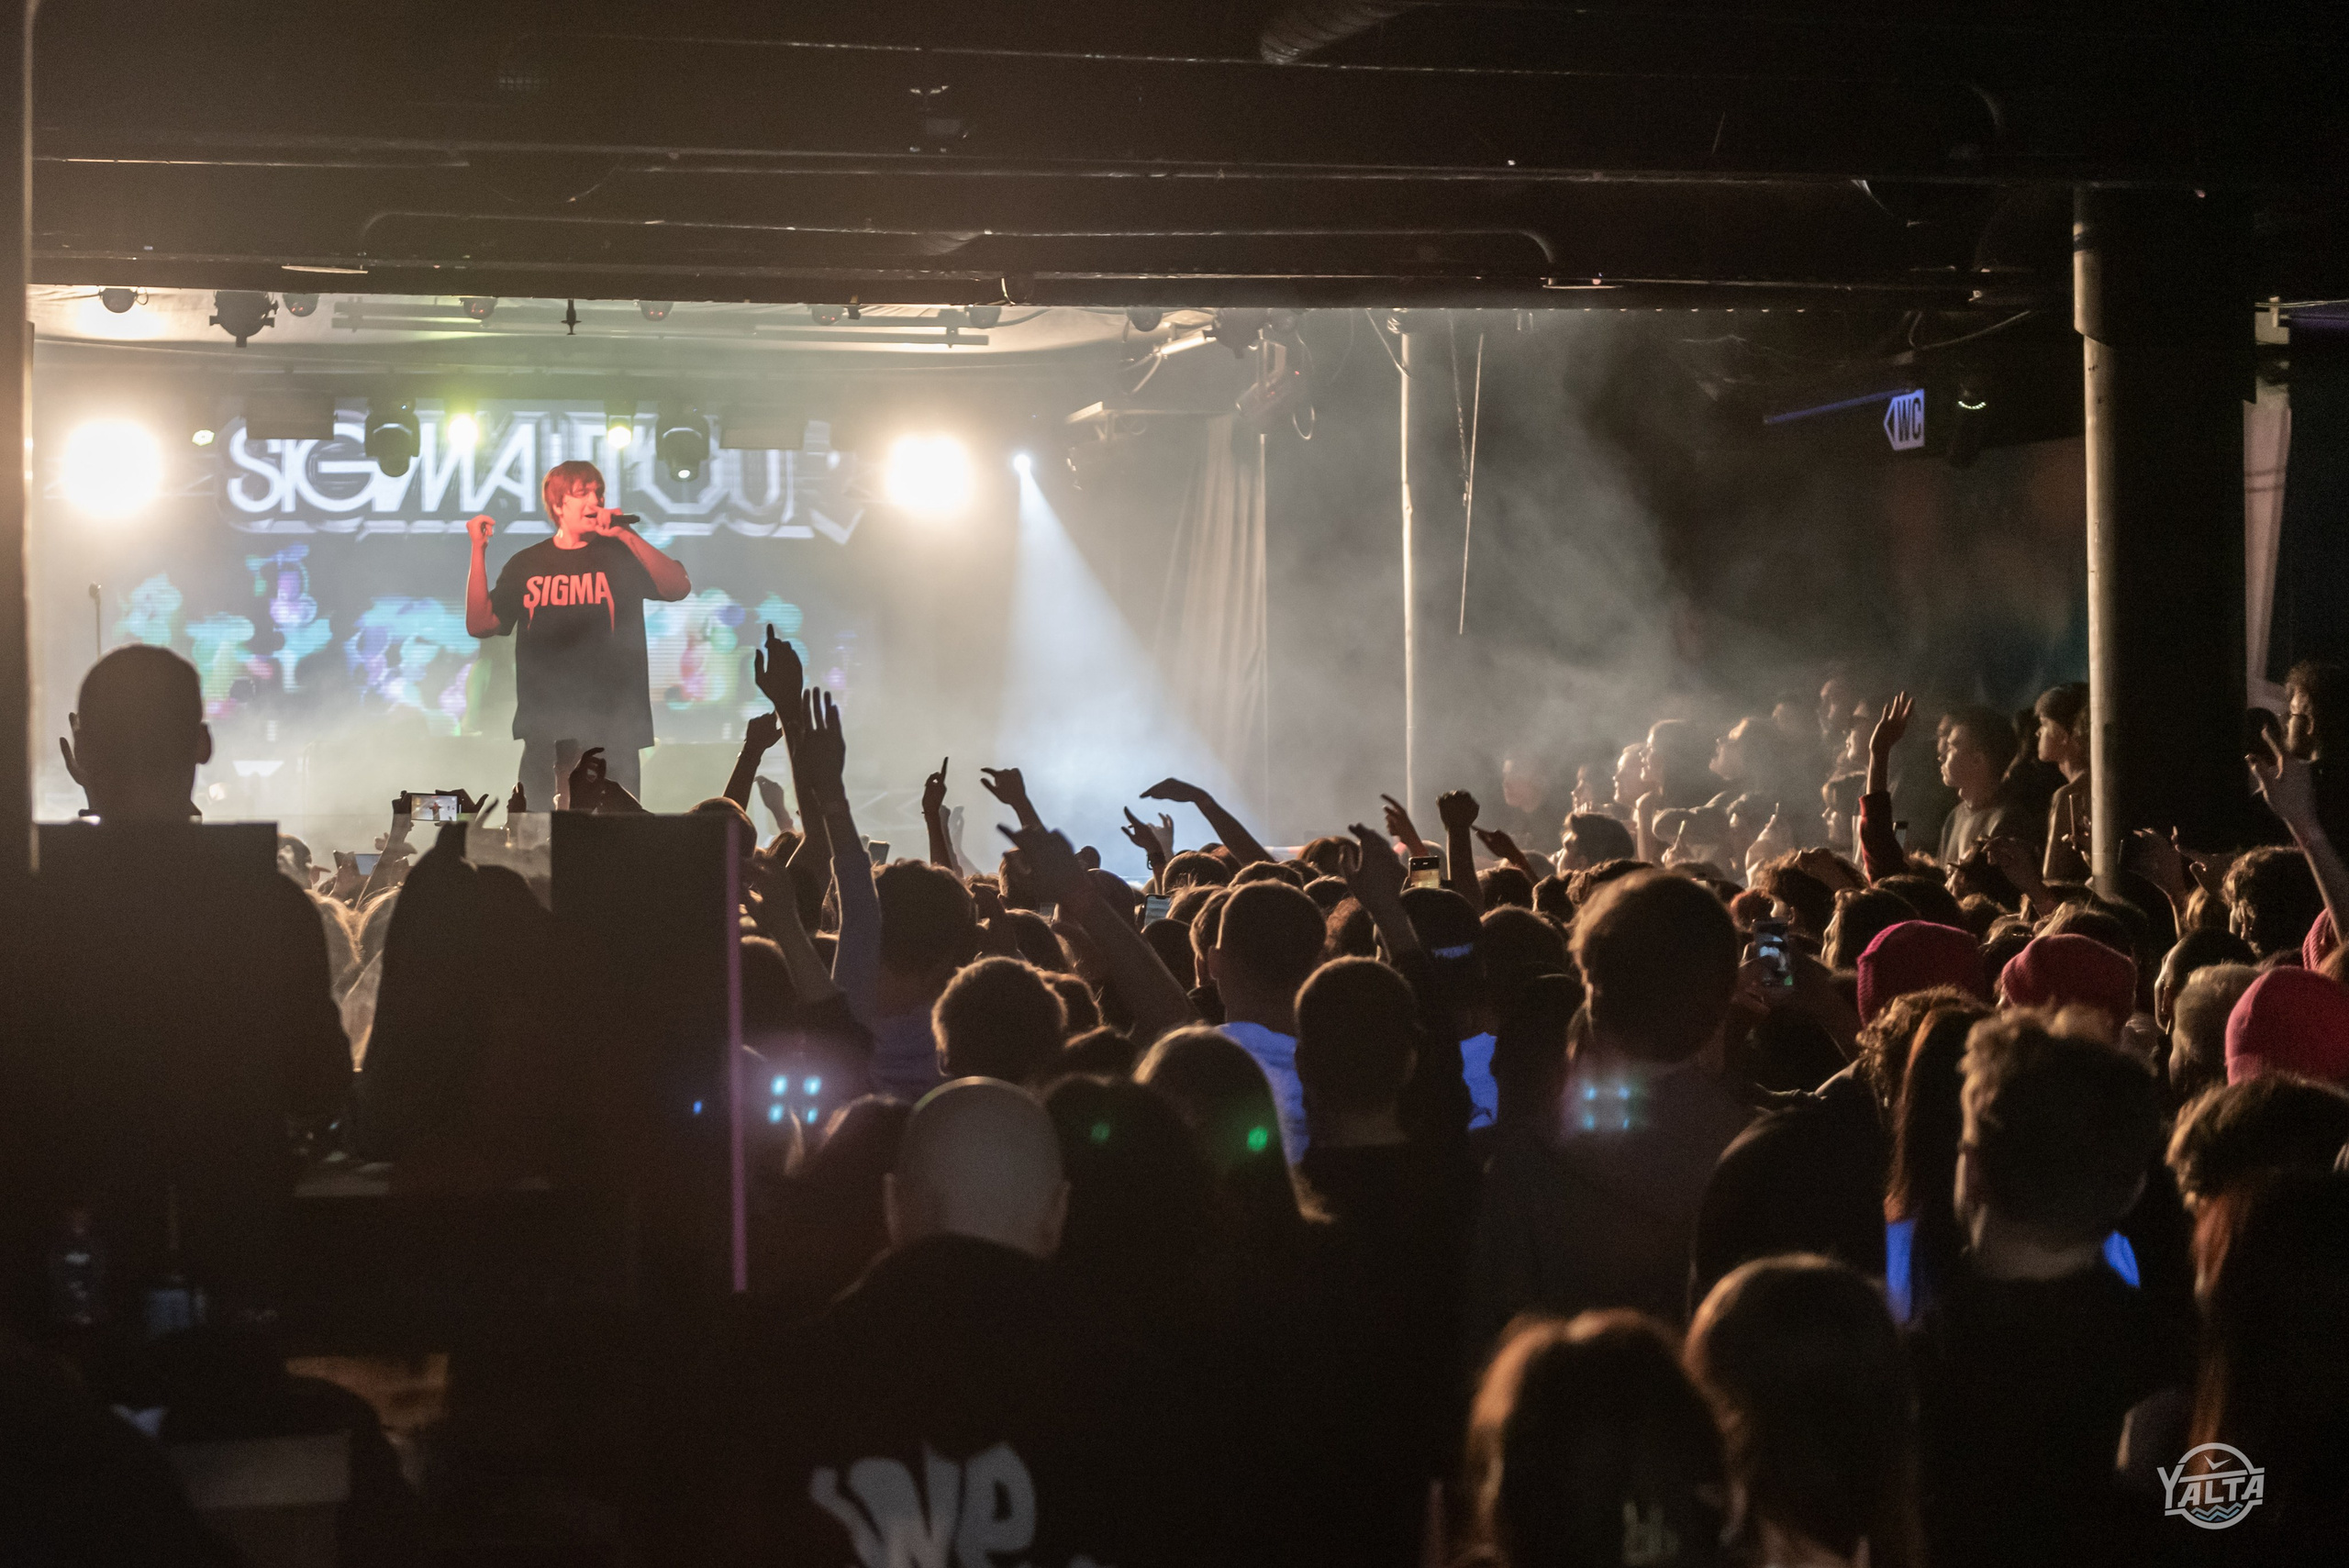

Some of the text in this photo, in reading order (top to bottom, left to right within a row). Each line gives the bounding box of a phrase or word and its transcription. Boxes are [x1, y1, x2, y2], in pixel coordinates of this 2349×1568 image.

[1897, 395, 1922, 443] WC
[227, 421, 536, 514] SIGMA
[523, 571, 615, 633] SIGMA
